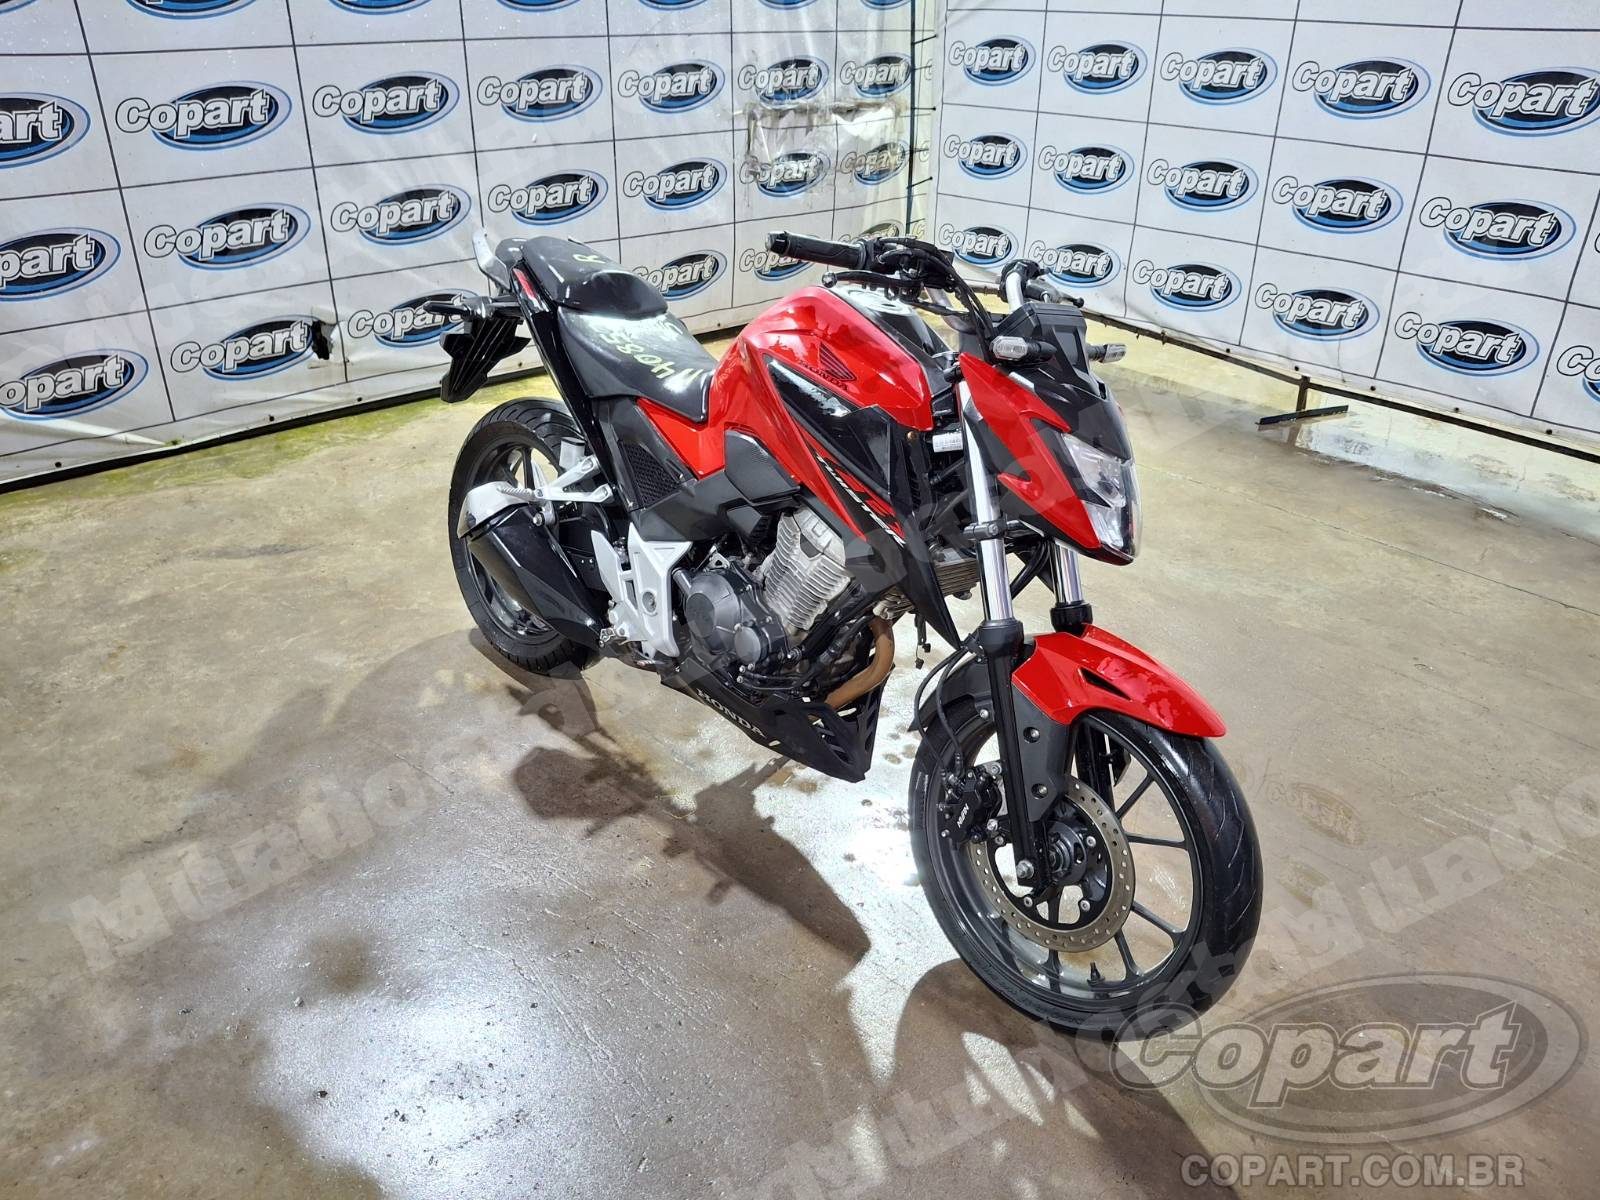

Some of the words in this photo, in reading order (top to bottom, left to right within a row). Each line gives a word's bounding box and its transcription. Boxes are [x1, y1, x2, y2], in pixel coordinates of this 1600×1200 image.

[839, 60, 908, 86] Copart
[949, 41, 1026, 75] Copart
[1047, 45, 1138, 82] Copart
[1160, 52, 1265, 92] Copart
[477, 72, 586, 112] Copart
[618, 66, 714, 104] Copart
[738, 63, 821, 96] Copart
[1292, 61, 1416, 104] Copart
[1447, 72, 1600, 119] Copart
[0, 101, 63, 144] art
[115, 88, 270, 139] Copart
[312, 79, 441, 124] Copart
[944, 134, 1020, 167] Copart
[1038, 145, 1125, 182] Copart
[488, 175, 594, 217] Copart
[623, 163, 716, 203] Copart
[1147, 158, 1247, 199] Copart
[1272, 175, 1390, 219] Copart
[144, 209, 289, 260] Copart
[330, 191, 455, 236] Copart
[1420, 197, 1557, 246] Copart
[0, 233, 95, 289] part
[938, 223, 1009, 259] Copart
[1029, 240, 1112, 278] Copart
[1132, 260, 1231, 301] Copart
[1255, 282, 1368, 328] Copart
[171, 320, 310, 372] Copart
[1395, 312, 1526, 365] Copart
[0, 353, 125, 412] opart
[696, 687, 768, 740] HONDA
